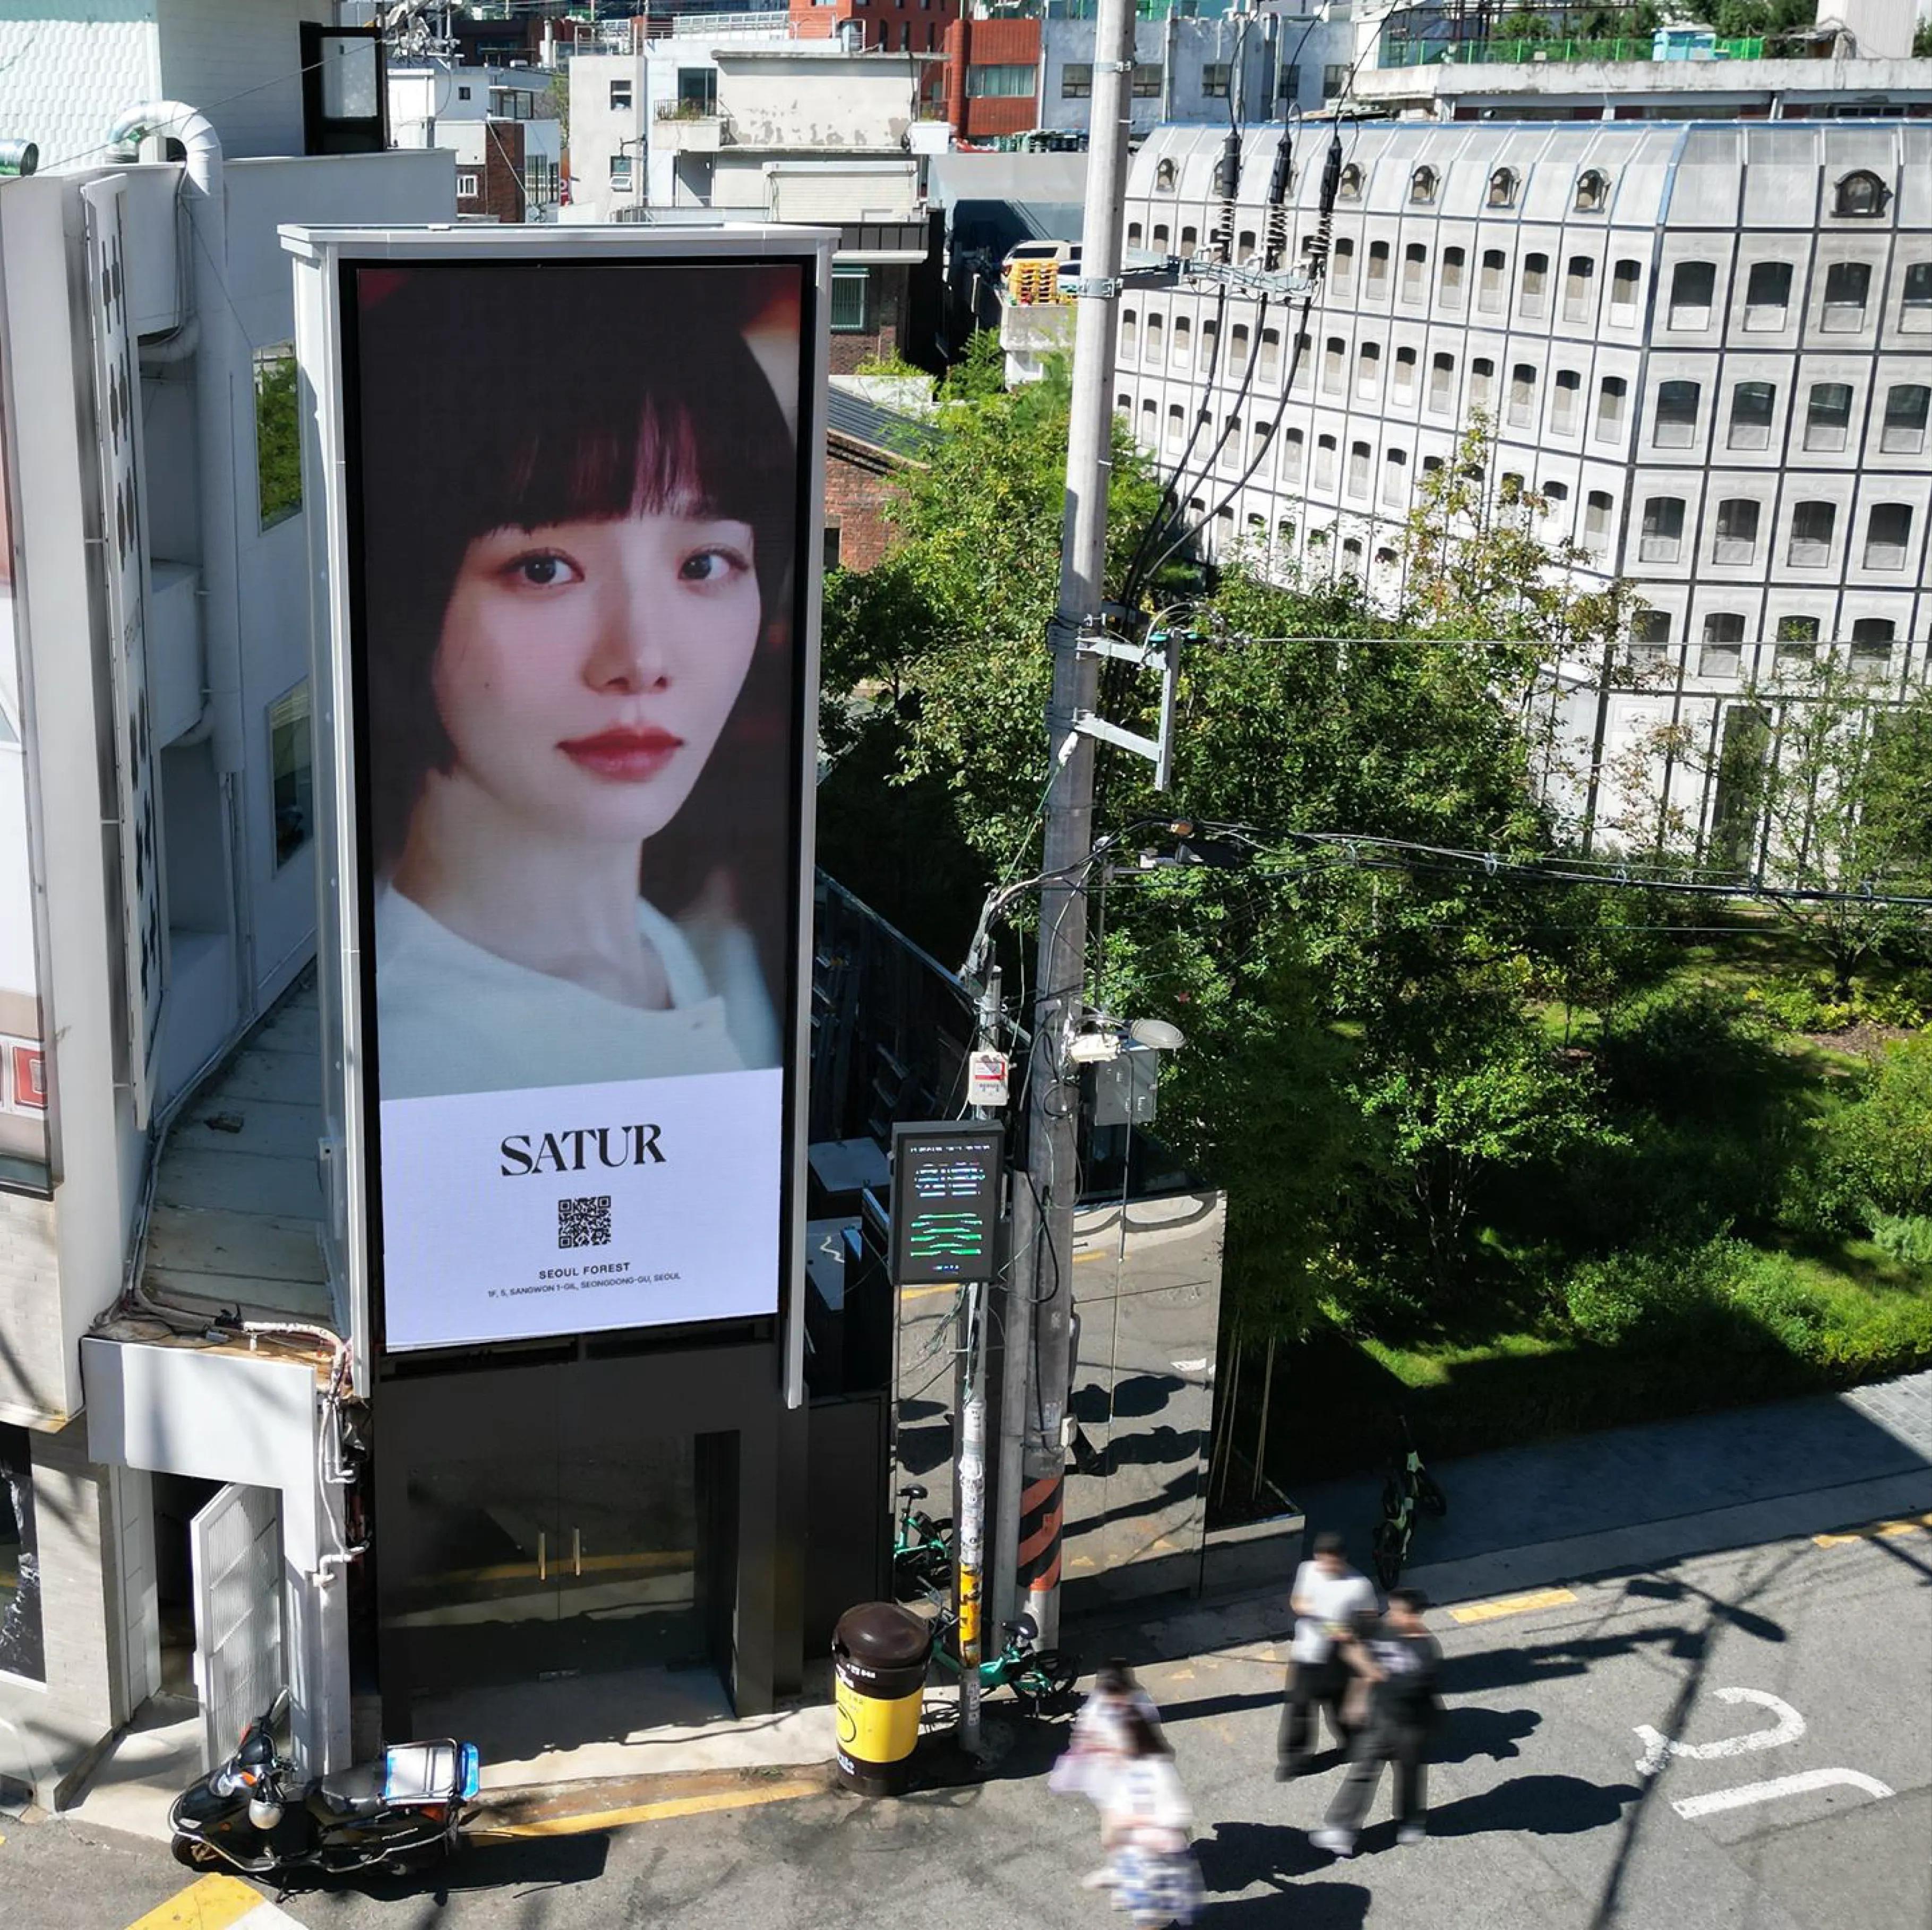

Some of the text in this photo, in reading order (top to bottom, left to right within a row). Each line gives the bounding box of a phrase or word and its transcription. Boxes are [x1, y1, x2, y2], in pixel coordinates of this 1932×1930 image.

[501, 1123, 666, 1177] SATUR
[539, 1262, 630, 1280] SEOUL FOREST
